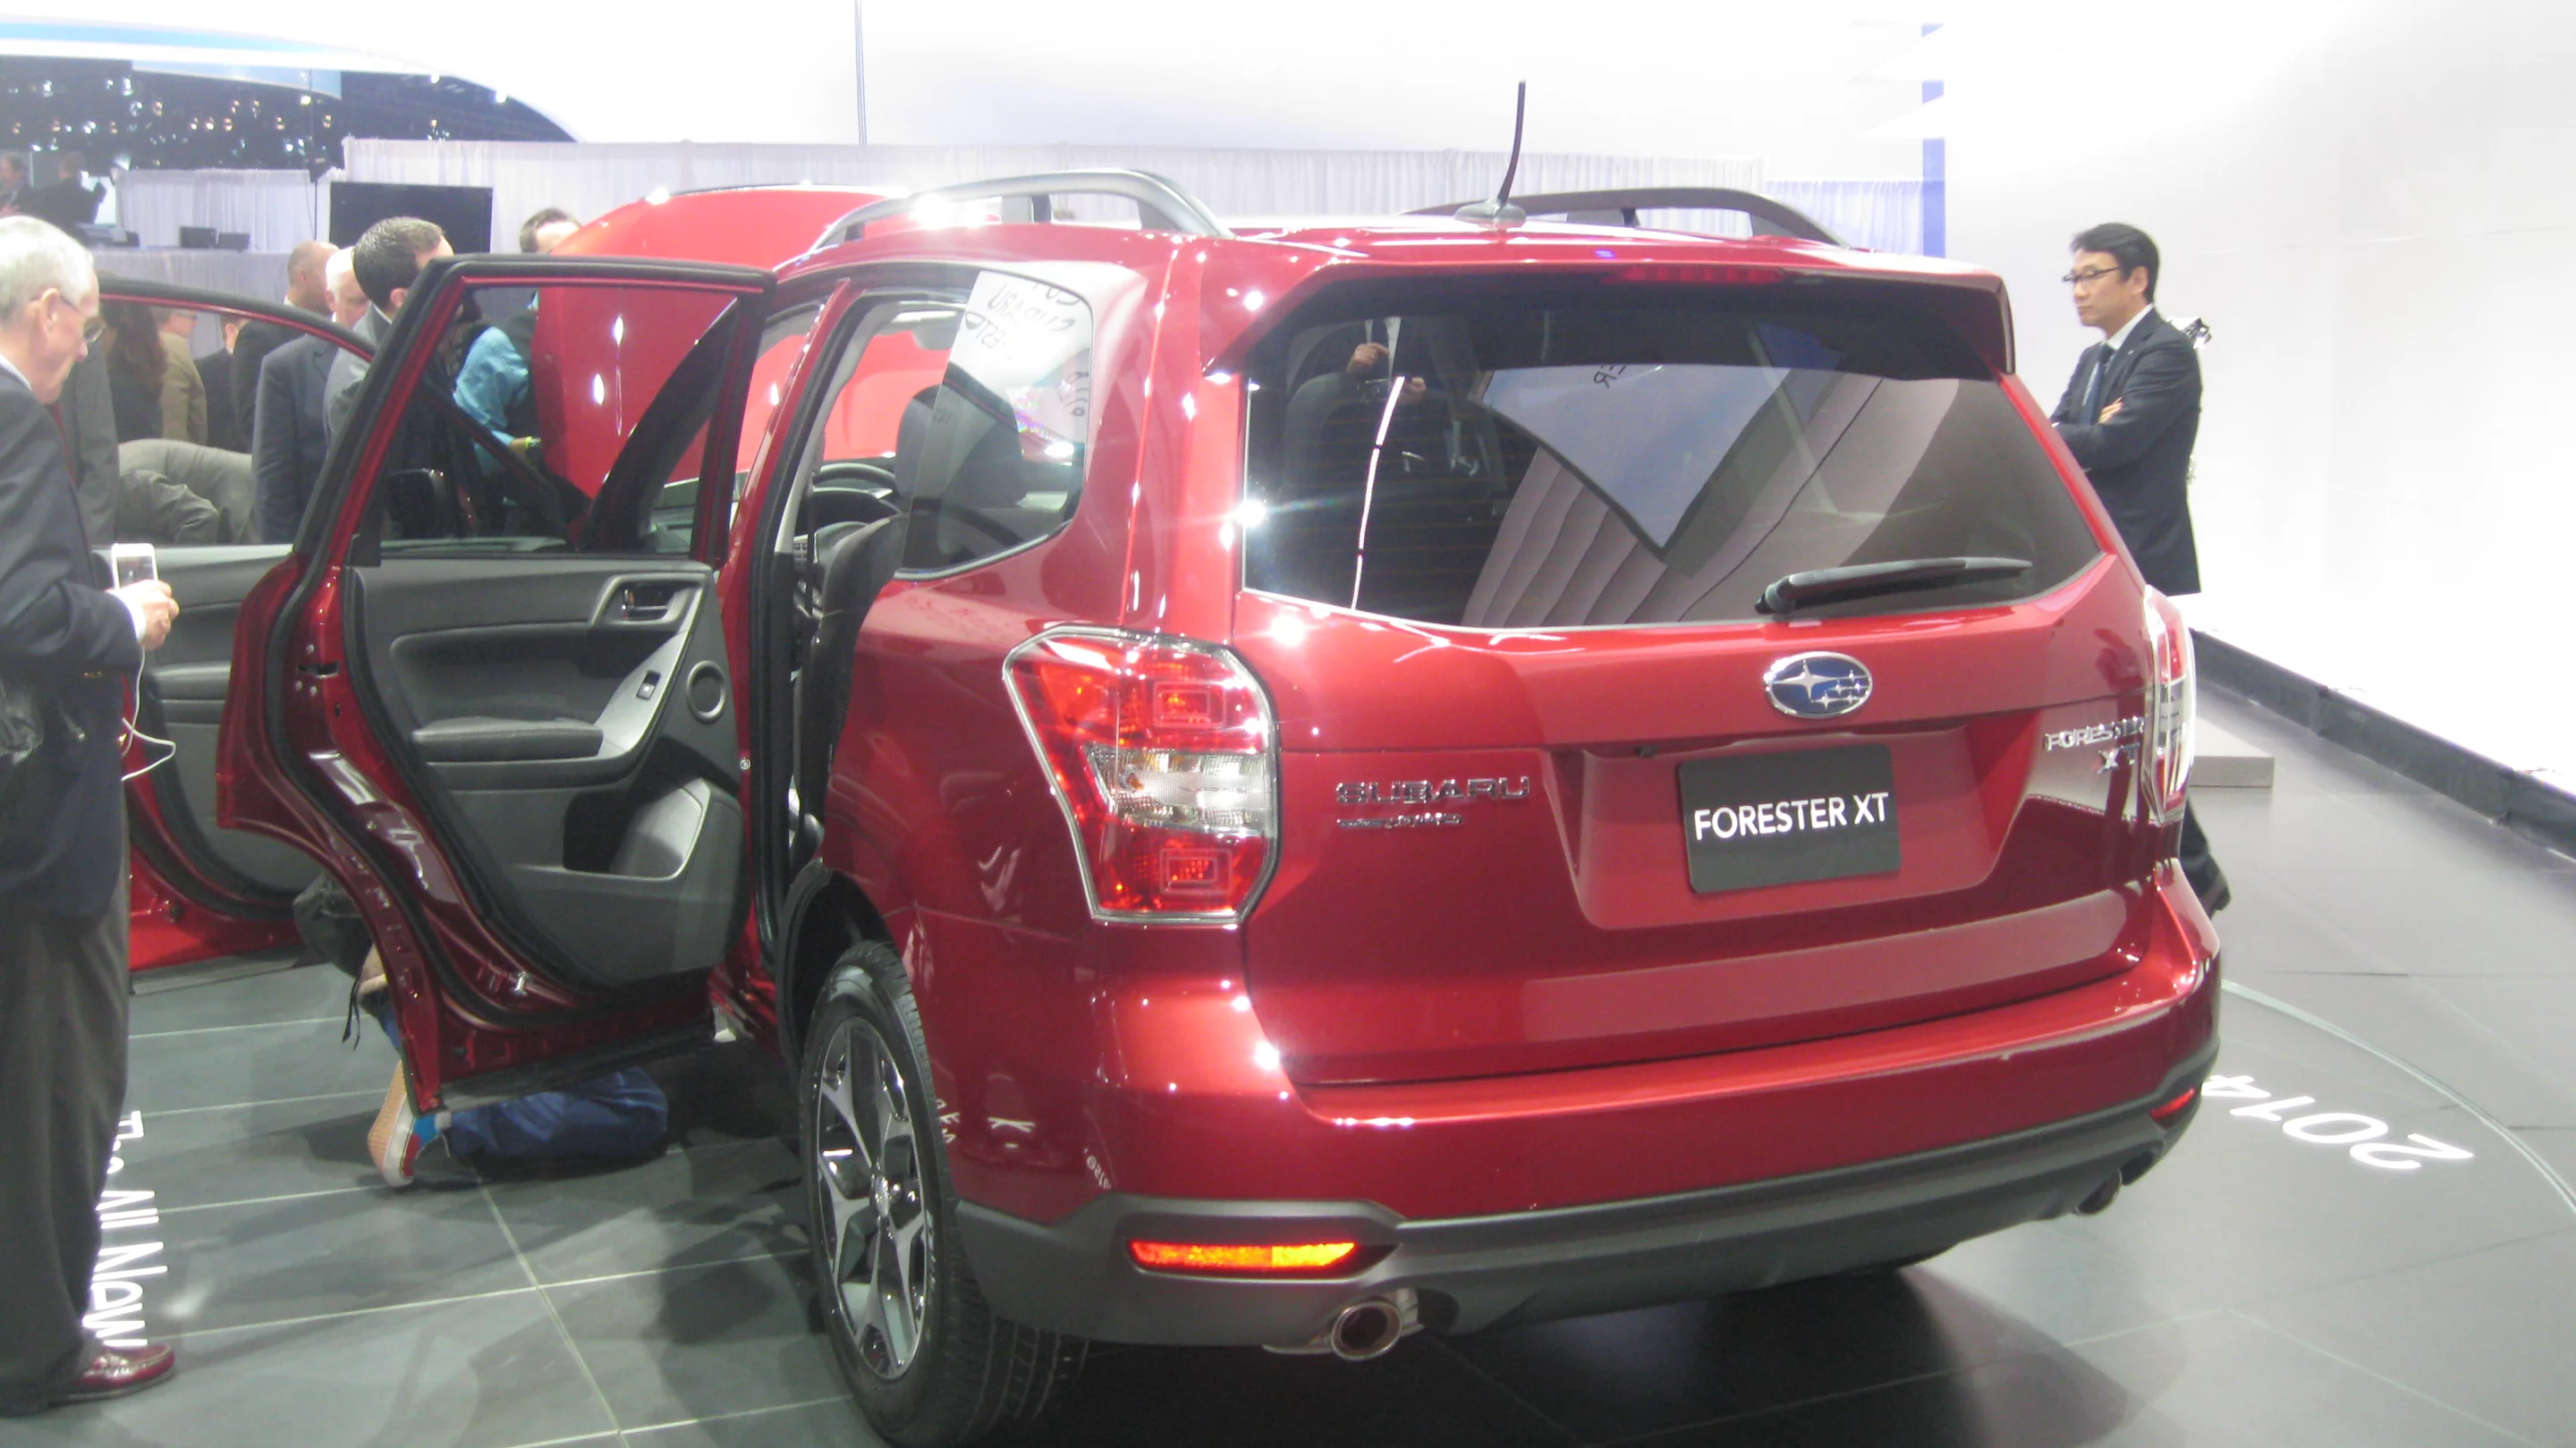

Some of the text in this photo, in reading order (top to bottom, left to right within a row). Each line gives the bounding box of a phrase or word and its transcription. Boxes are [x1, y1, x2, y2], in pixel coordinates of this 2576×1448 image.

[2097, 741, 2141, 775] XT
[1336, 776, 1530, 803] SUBARU
[1694, 792, 1889, 841] FORESTER XT
[2200, 1073, 2475, 1170] 2014
[82, 1241, 168, 1348] New
